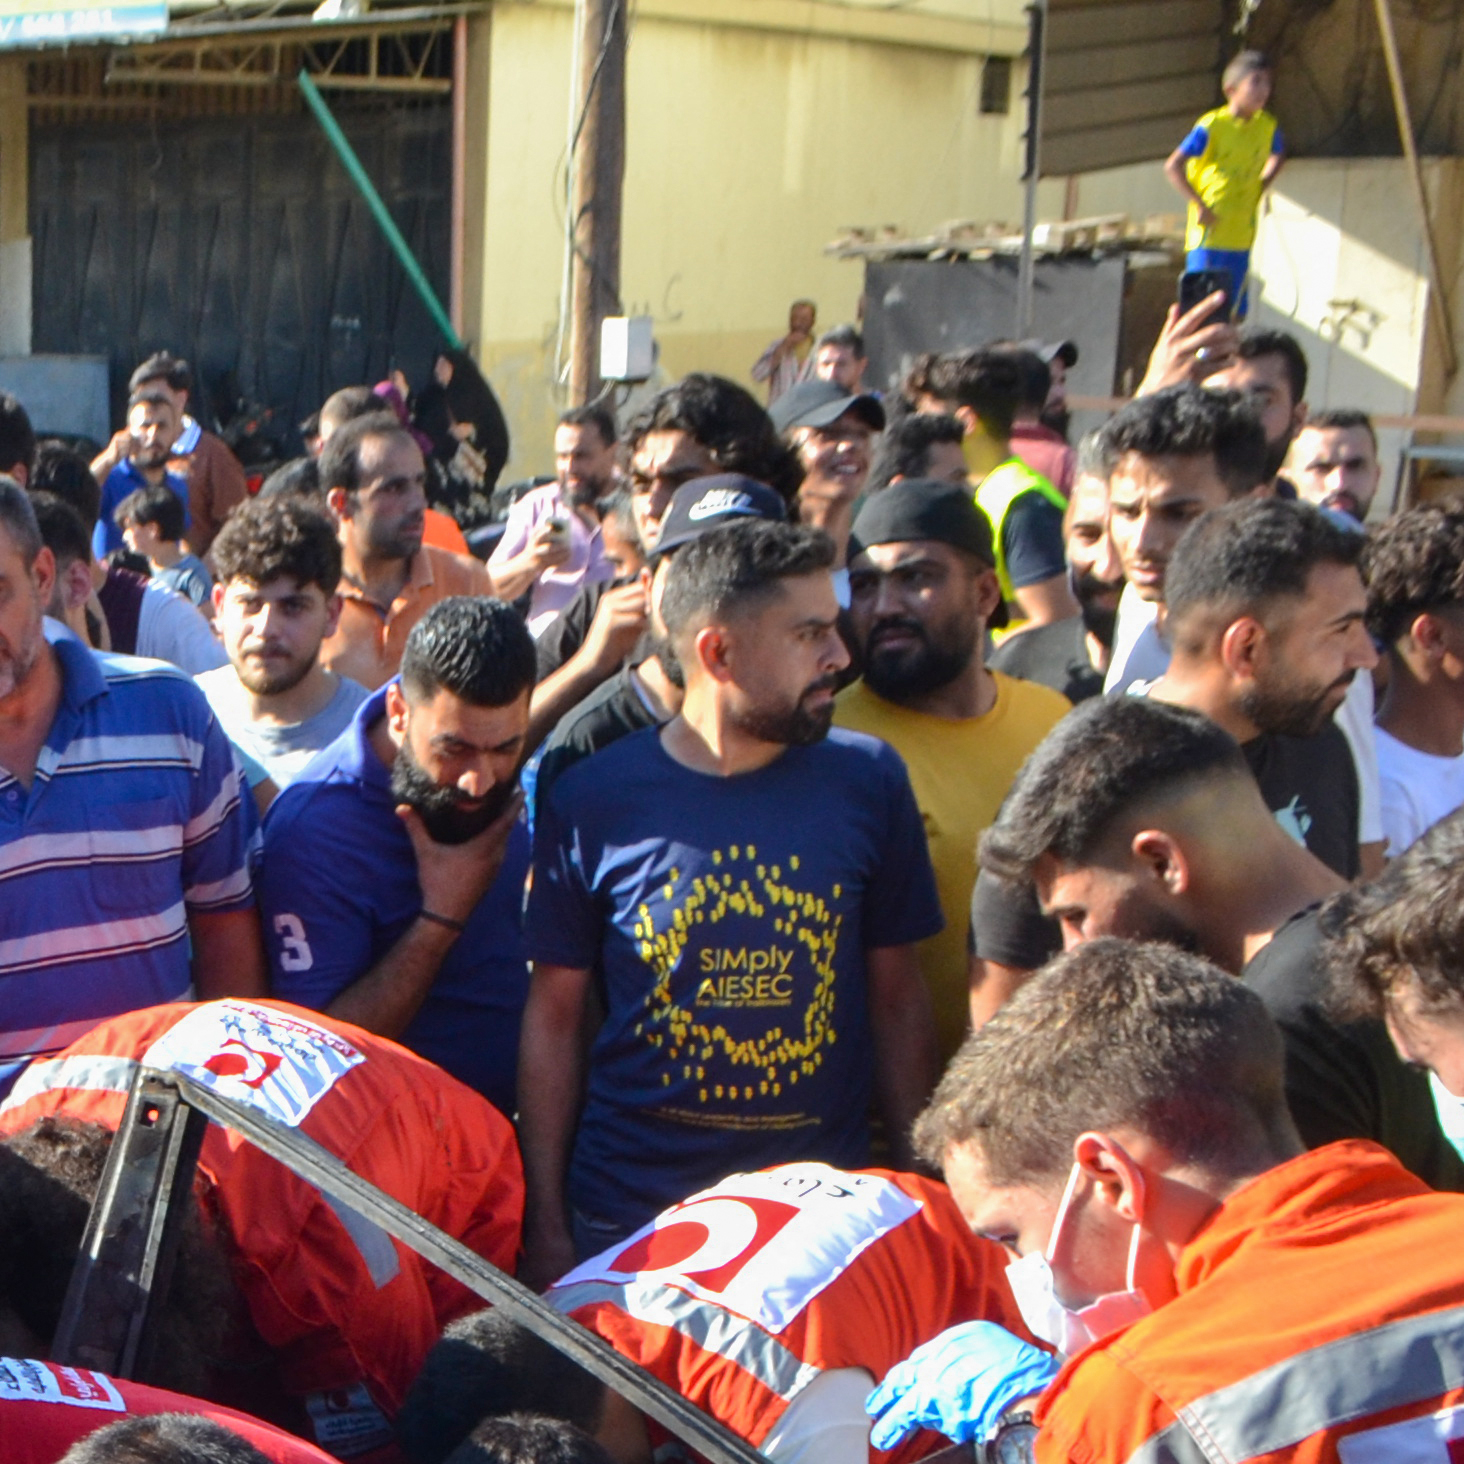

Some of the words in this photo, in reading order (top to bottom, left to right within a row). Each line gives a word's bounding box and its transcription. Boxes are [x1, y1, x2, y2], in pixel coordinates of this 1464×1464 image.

[274, 913, 313, 972] 3
[700, 944, 794, 974] SIMply
[697, 973, 793, 999] AIESEC
